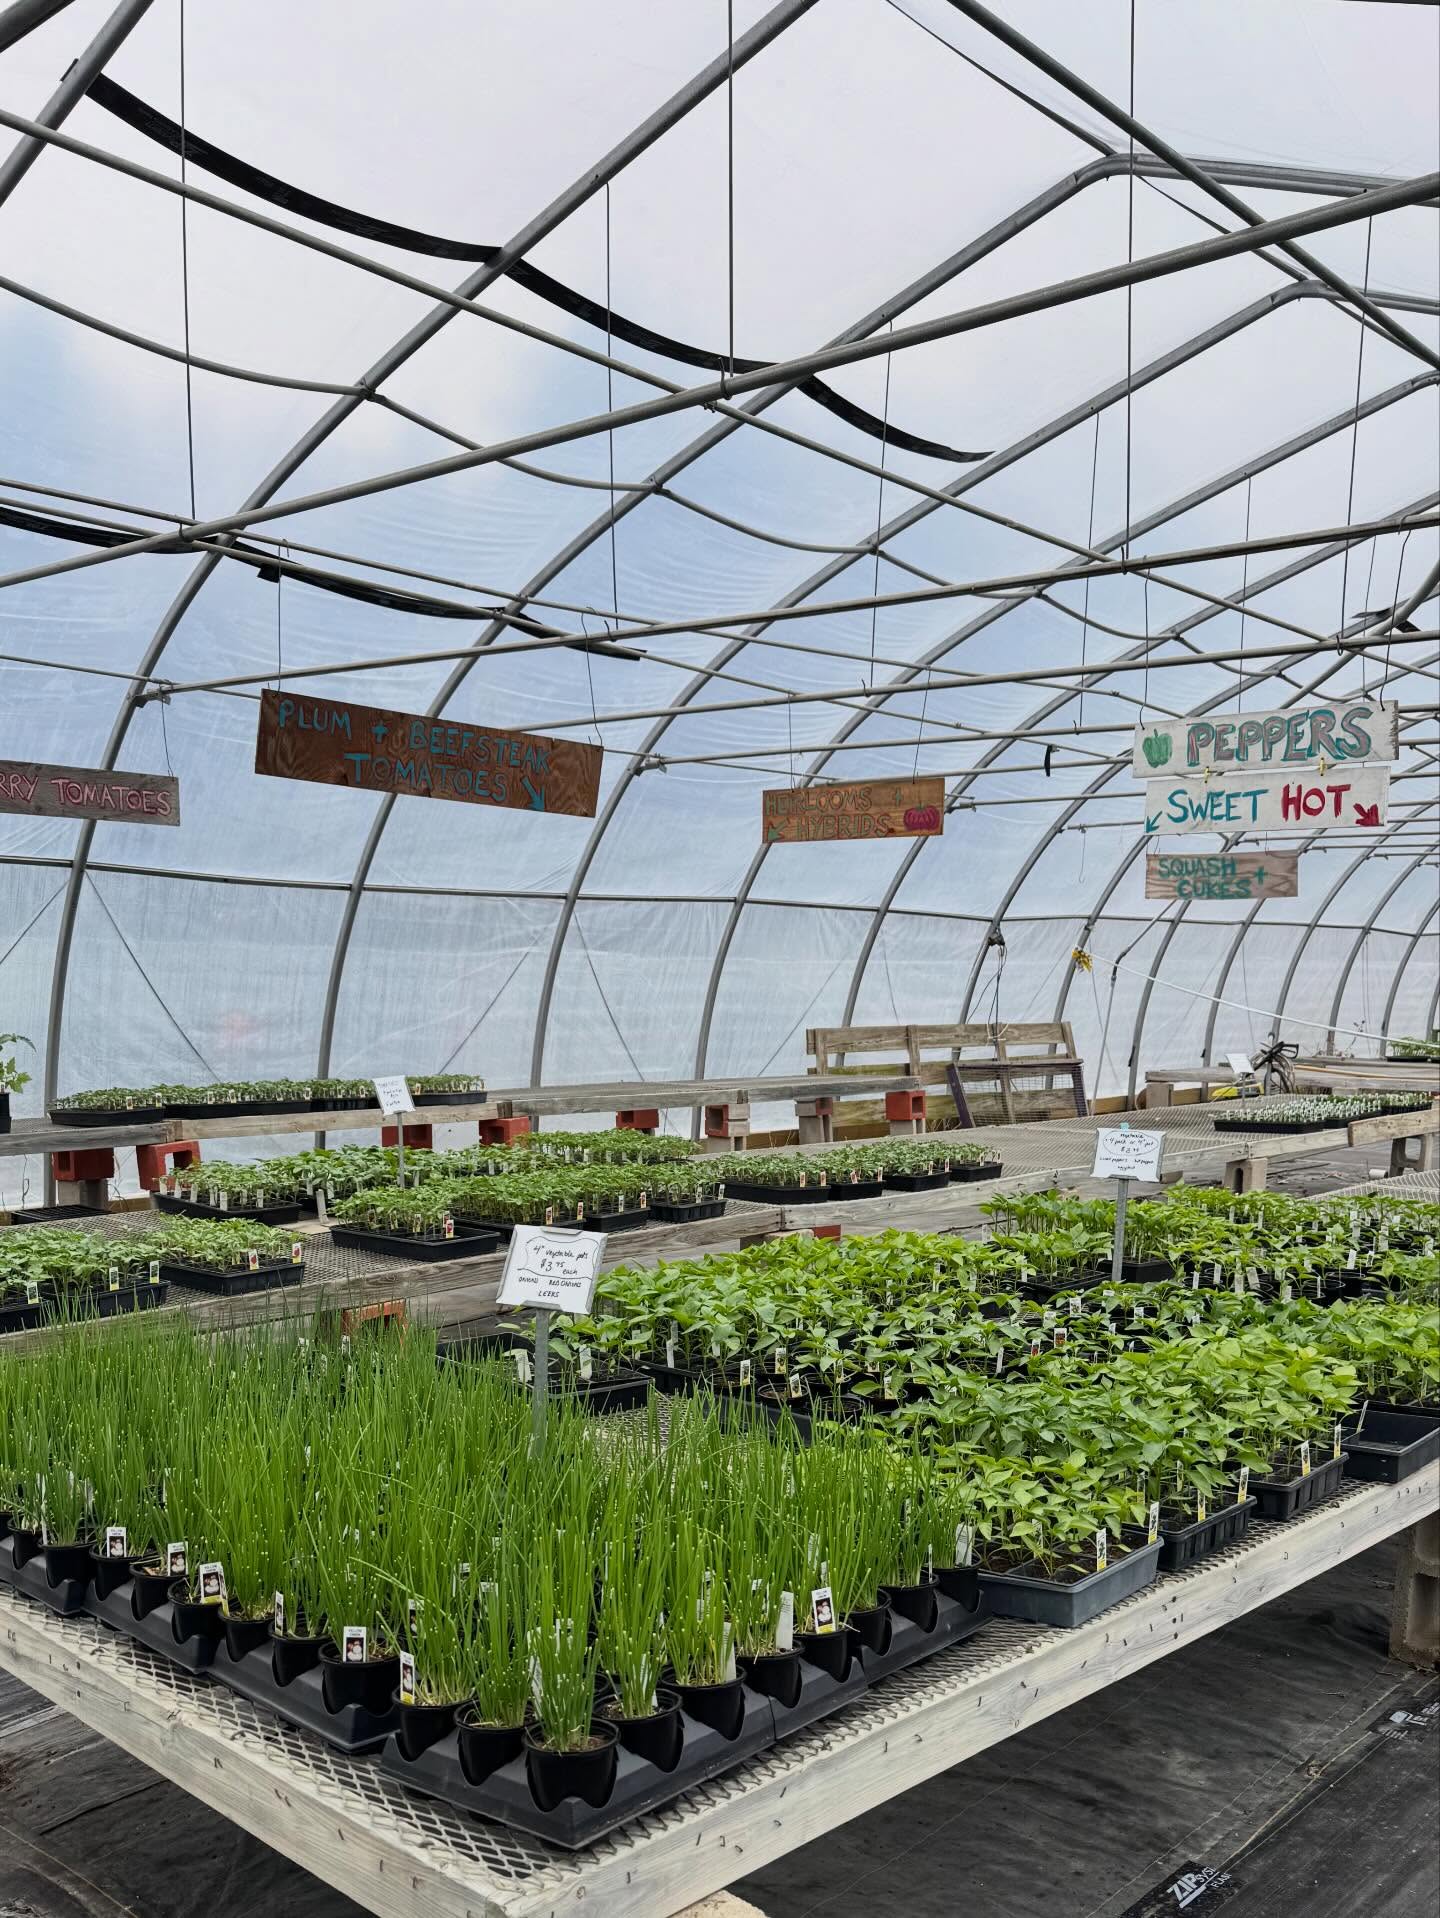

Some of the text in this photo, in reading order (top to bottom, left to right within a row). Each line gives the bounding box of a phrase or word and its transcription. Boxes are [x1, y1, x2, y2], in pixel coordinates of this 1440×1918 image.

[279, 699, 550, 775] PLUM + BEEFSTEAK
[1186, 707, 1374, 767] PEPPERS
[343, 752, 507, 801] TOMATOES
[51, 777, 172, 816] TOMATOES
[1166, 783, 1352, 824] SWEET HOT
[1157, 856, 1238, 879] SQUASH
[1176, 879, 1251, 899] CUKES
[538, 1290, 560, 1298] LEEKS
[1166, 1872, 1198, 1902] ZIP
